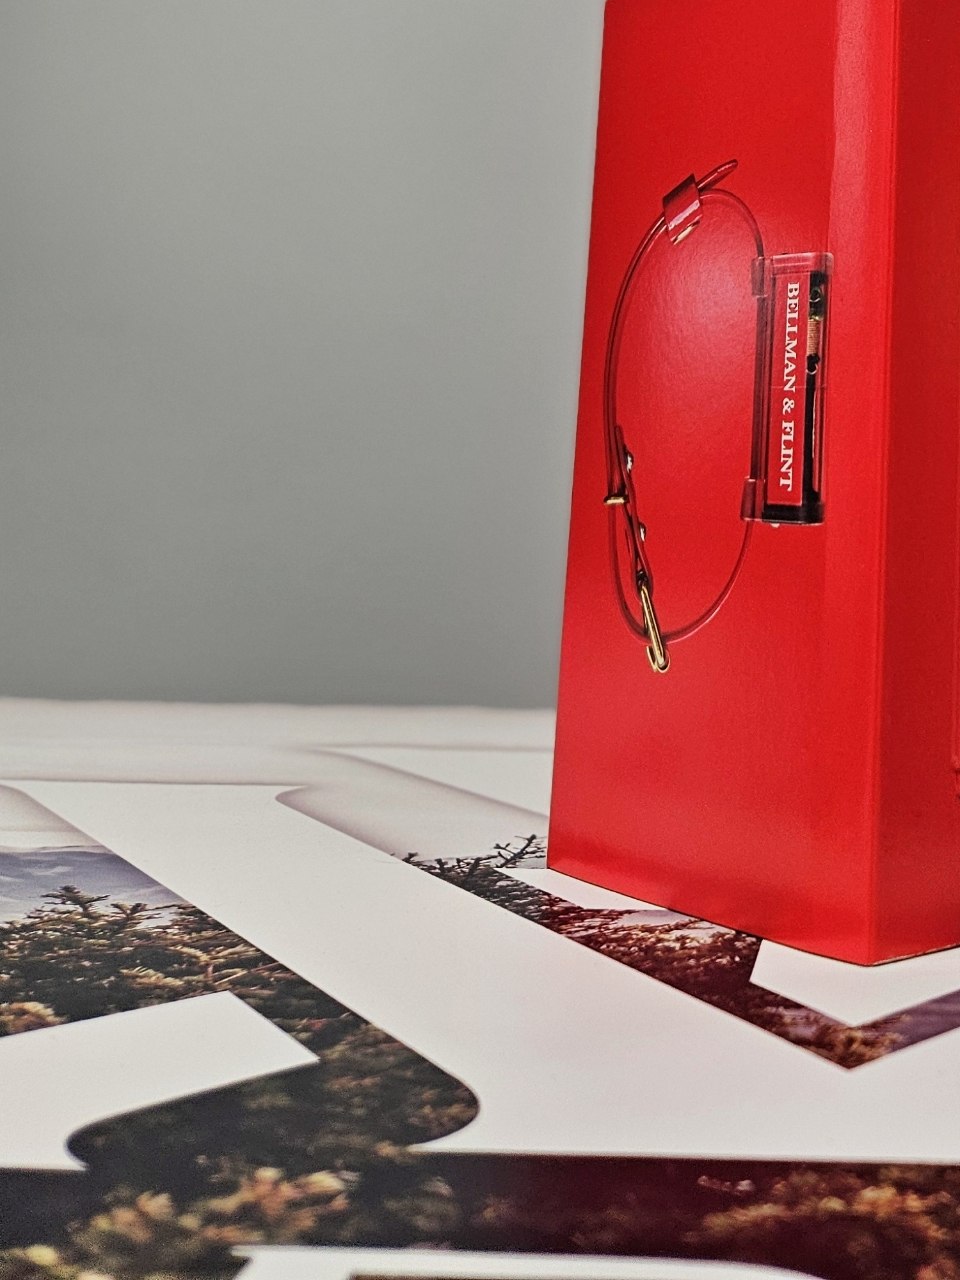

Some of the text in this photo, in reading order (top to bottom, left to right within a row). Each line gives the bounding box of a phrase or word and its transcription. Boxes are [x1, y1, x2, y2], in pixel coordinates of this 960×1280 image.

[779, 281, 801, 492] BELLMAN & FLINT
